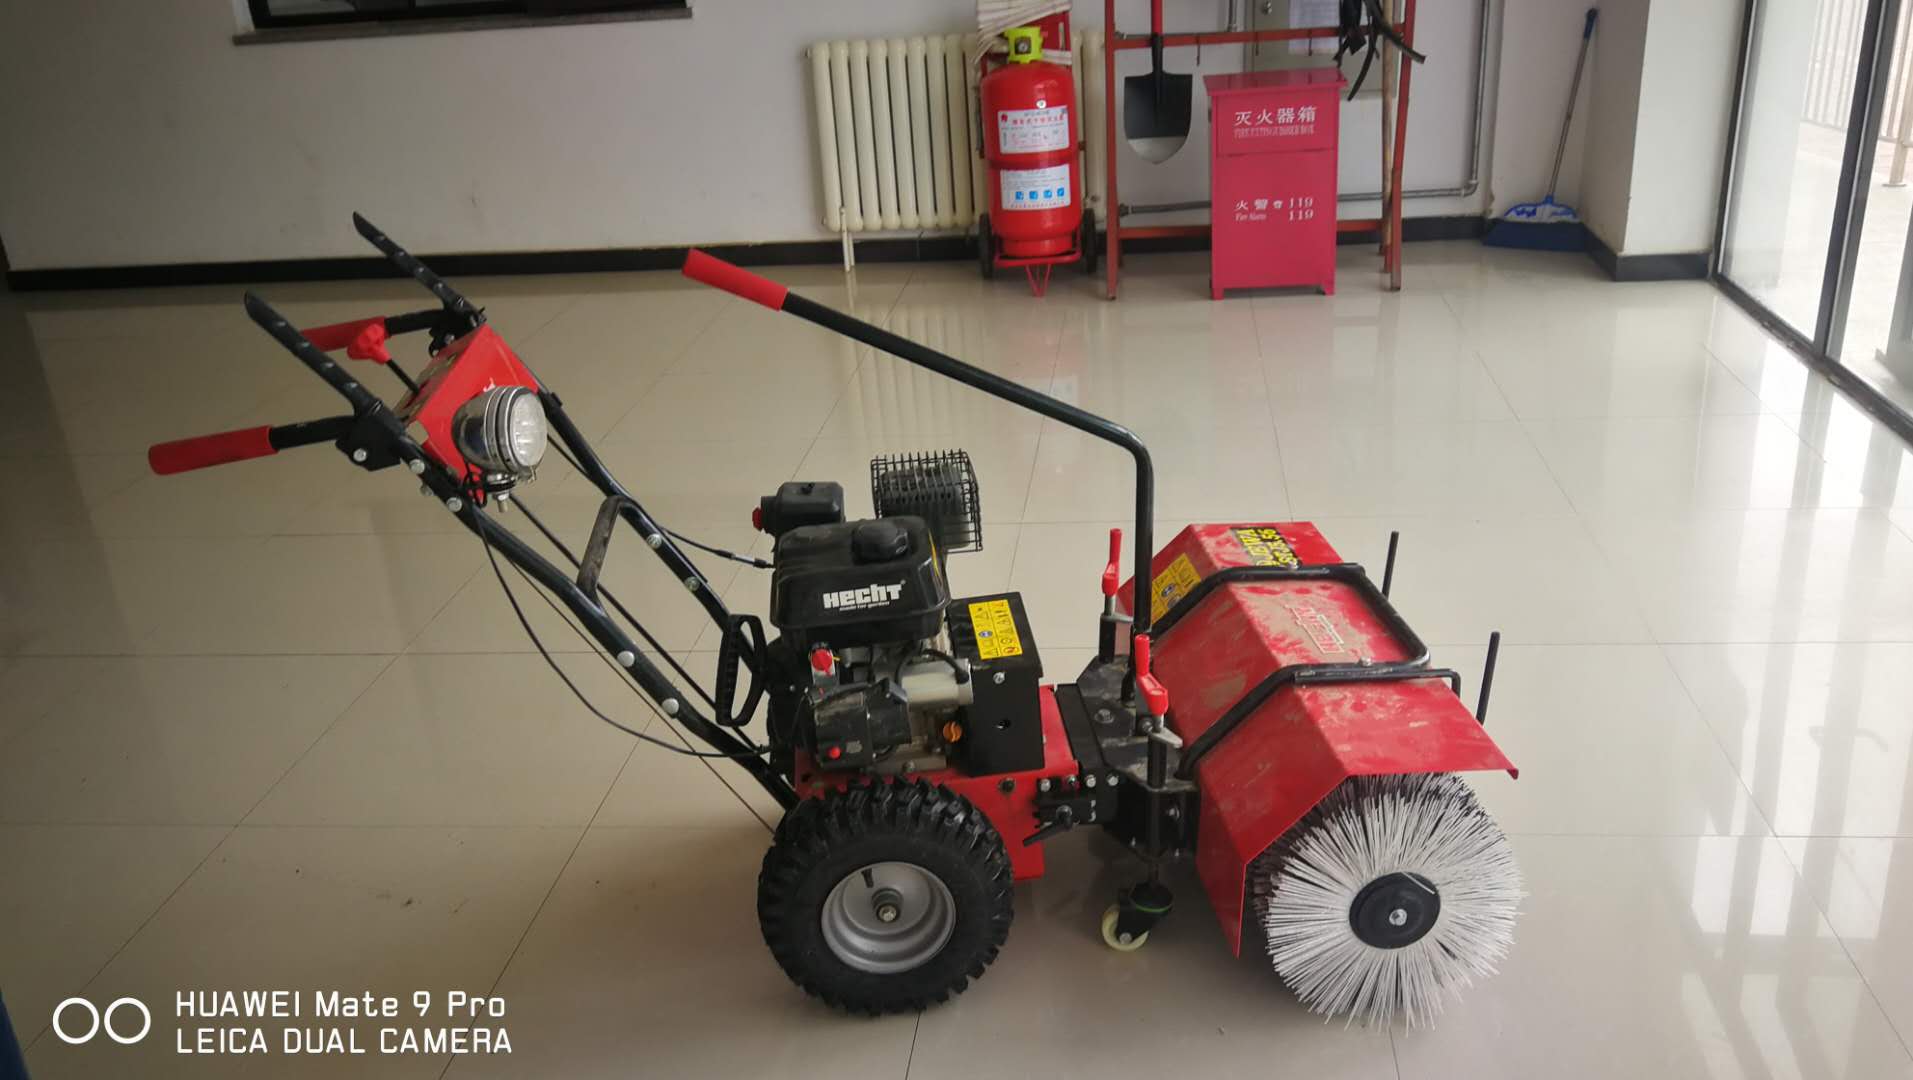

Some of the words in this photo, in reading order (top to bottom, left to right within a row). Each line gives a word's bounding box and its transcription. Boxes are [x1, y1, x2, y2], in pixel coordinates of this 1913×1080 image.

[1234, 105, 1316, 126] 灭火器箱
[1290, 197, 1313, 209] 119
[1289, 209, 1314, 221] 119
